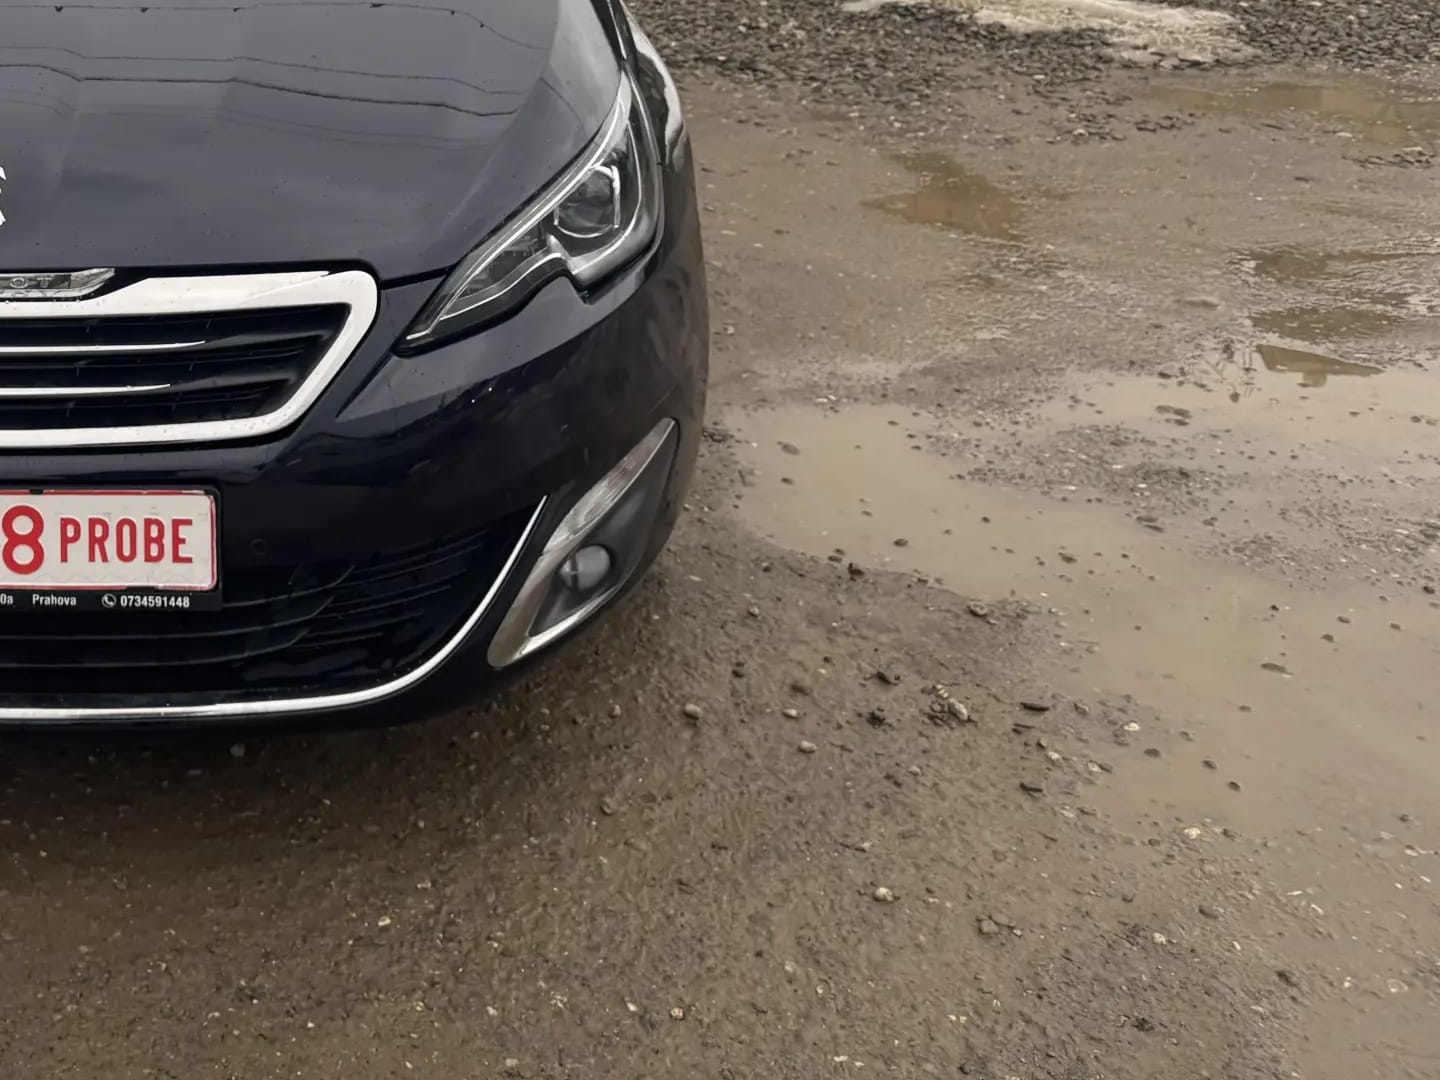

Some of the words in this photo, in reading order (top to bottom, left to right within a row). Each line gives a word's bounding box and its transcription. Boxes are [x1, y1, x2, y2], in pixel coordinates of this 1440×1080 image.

[60, 517, 194, 564] PROBE
[32, 593, 77, 606] Prahova
[120, 595, 190, 608] 0734591448
